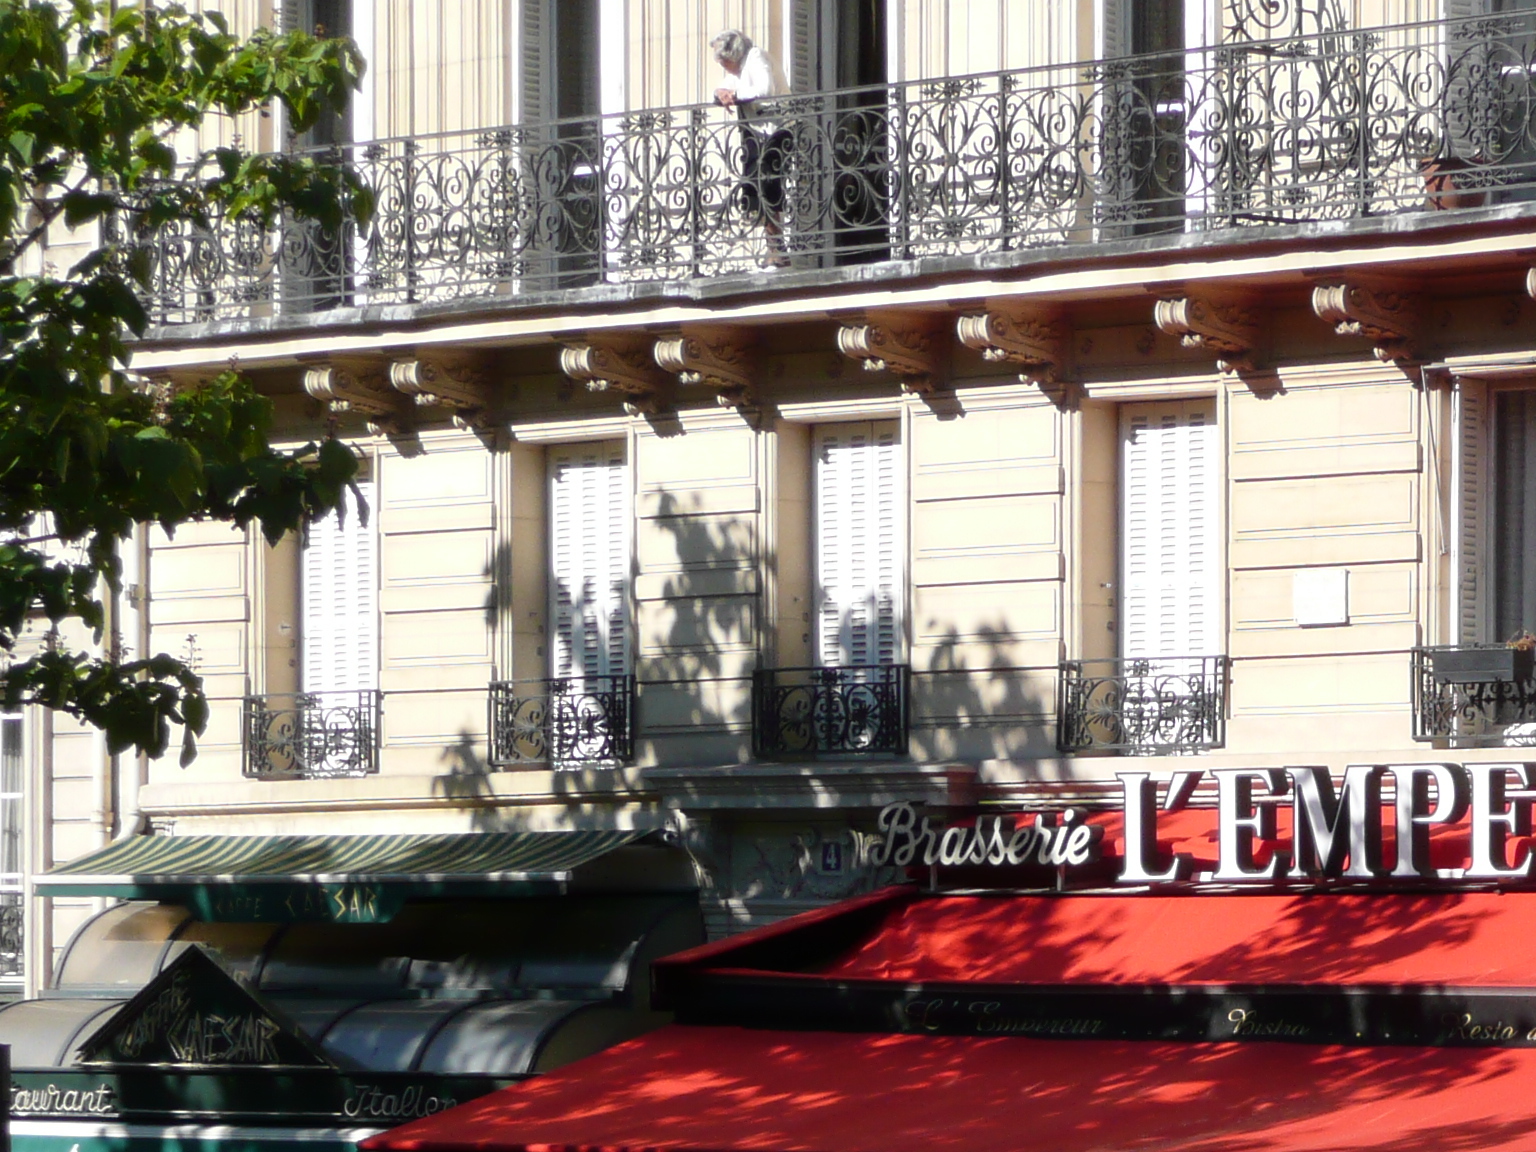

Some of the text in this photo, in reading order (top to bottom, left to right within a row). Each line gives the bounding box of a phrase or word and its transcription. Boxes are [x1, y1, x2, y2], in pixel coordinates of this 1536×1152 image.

[871, 801, 1091, 866] Brasserie
[284, 886, 377, 920] CAESAR
[166, 1008, 281, 1062] CAESAR
[1441, 1013, 1515, 1043] Resto
